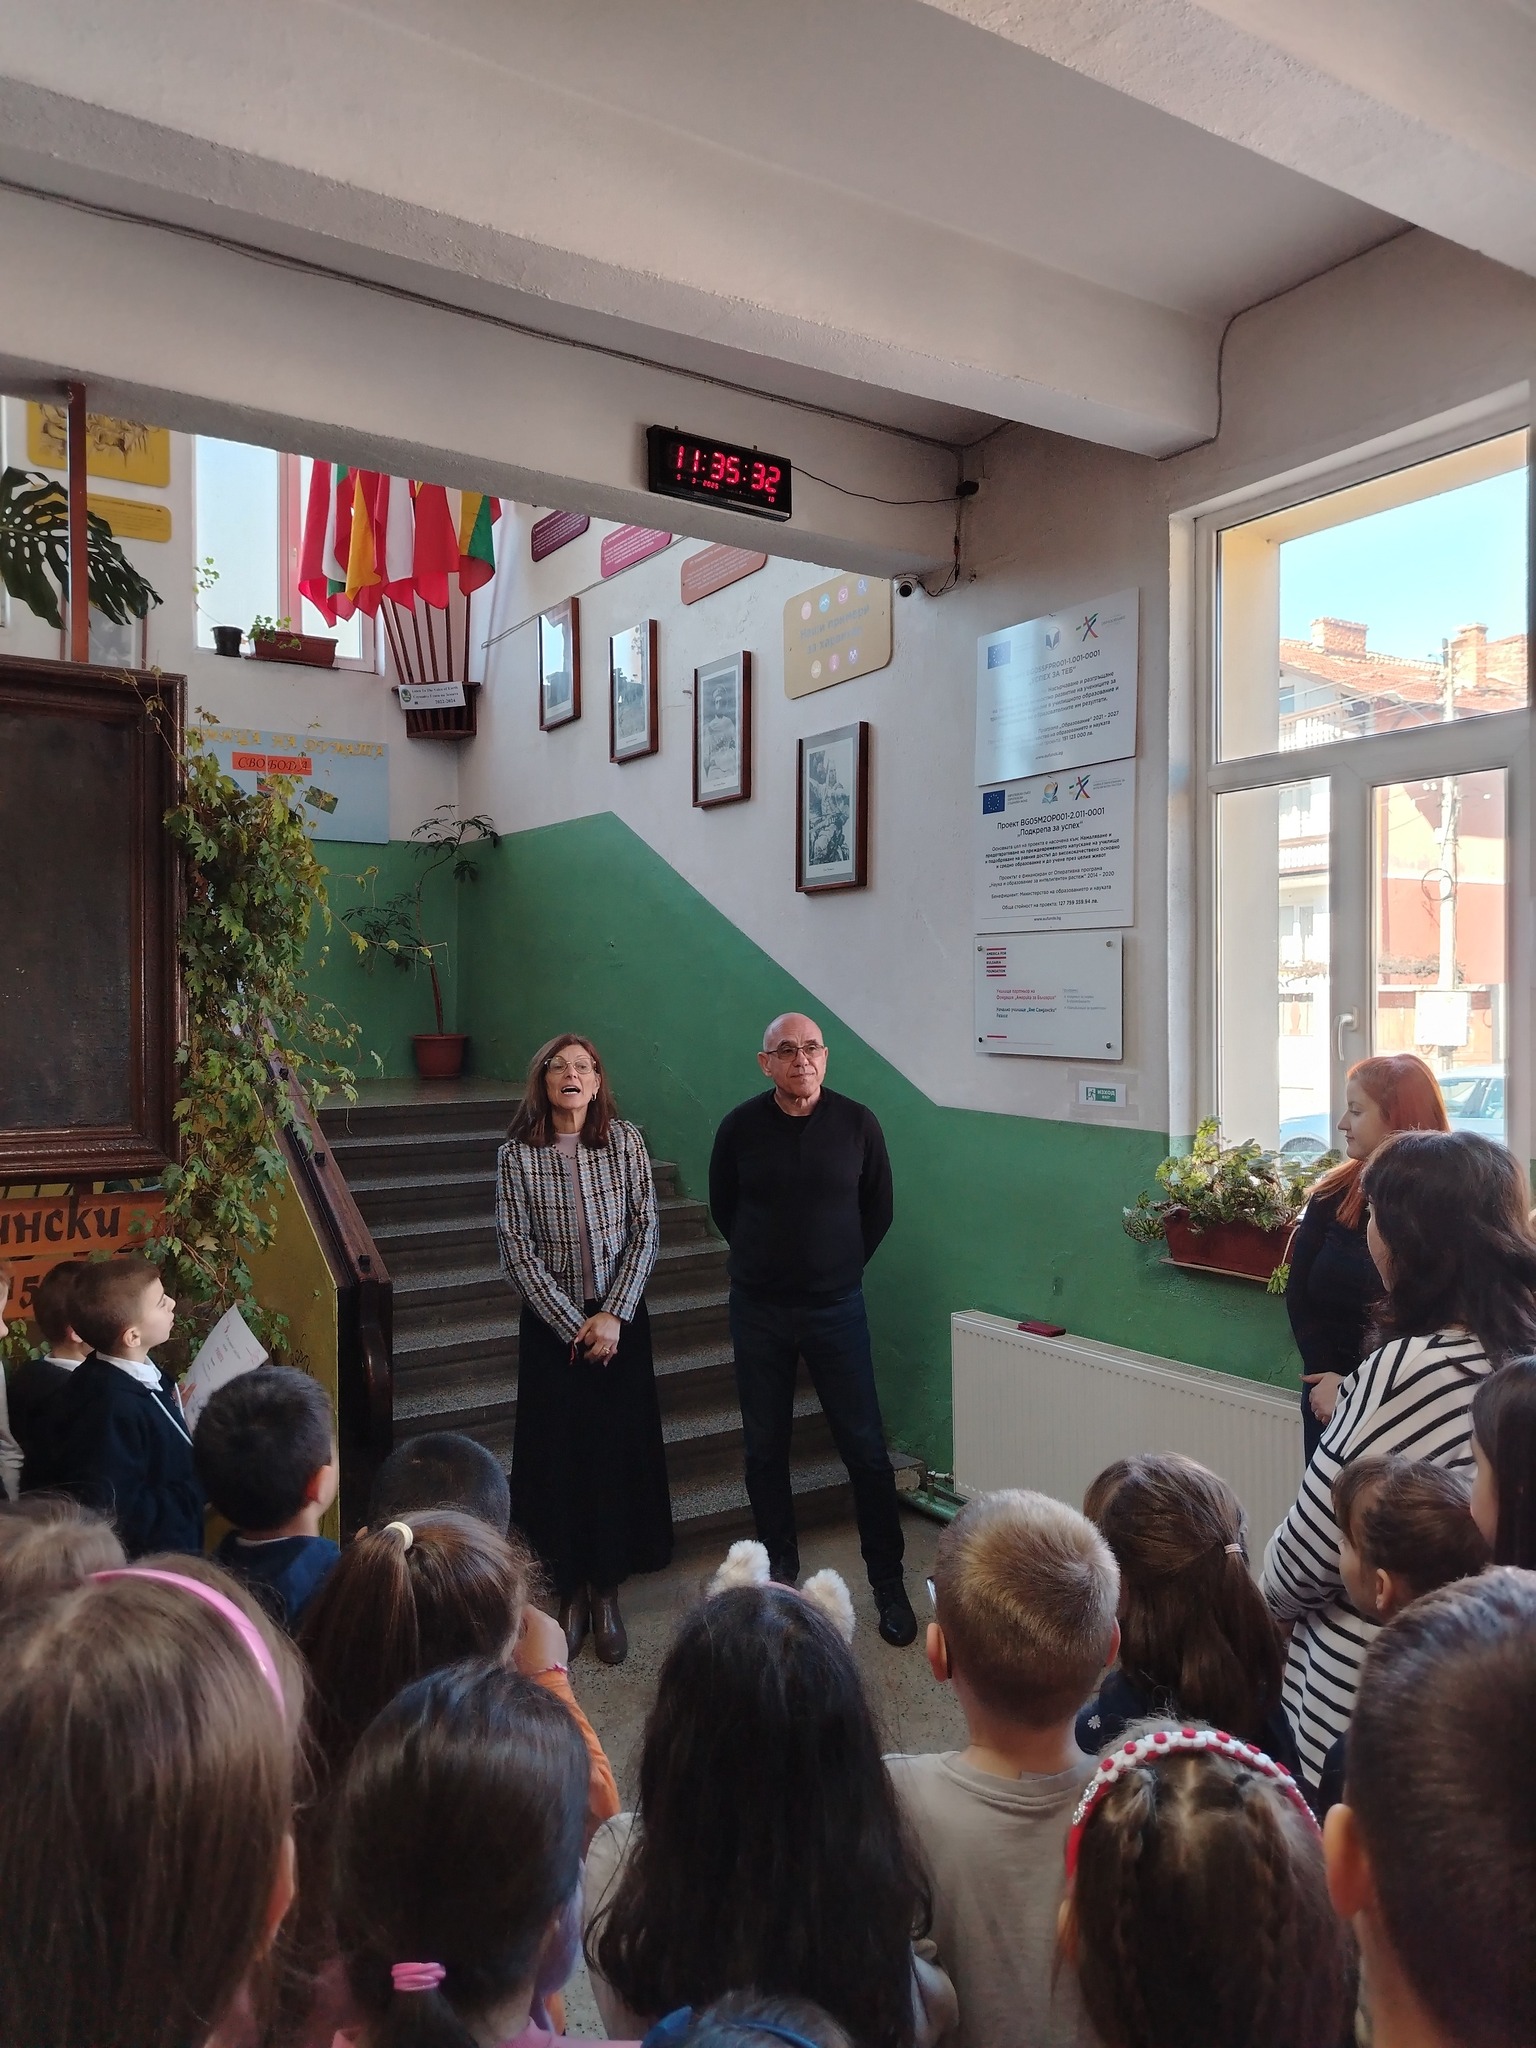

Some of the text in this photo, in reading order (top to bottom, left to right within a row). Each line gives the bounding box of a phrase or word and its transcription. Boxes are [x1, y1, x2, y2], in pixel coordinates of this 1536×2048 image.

[677, 445, 781, 493] 11:35:32
[702, 479, 719, 490] 2025
[1052, 670, 1060, 678] ЗА
[1055, 689, 1076, 699] развитие
[1082, 686, 1114, 699] образование
[1108, 710, 1119, 718] 2027
[1056, 725, 1088, 736] образованието
[1093, 721, 1110, 729] науката
[997, 820, 1019, 831] Проект
[1017, 825, 1051, 838] „Подкрепа
[1061, 821, 1083, 832] успех“
[1026, 845, 1067, 854] преждевременното
[1059, 847, 1099, 856] висококачествено
[1022, 871, 1047, 879] финансиран
[1056, 886, 1089, 894] образованието
